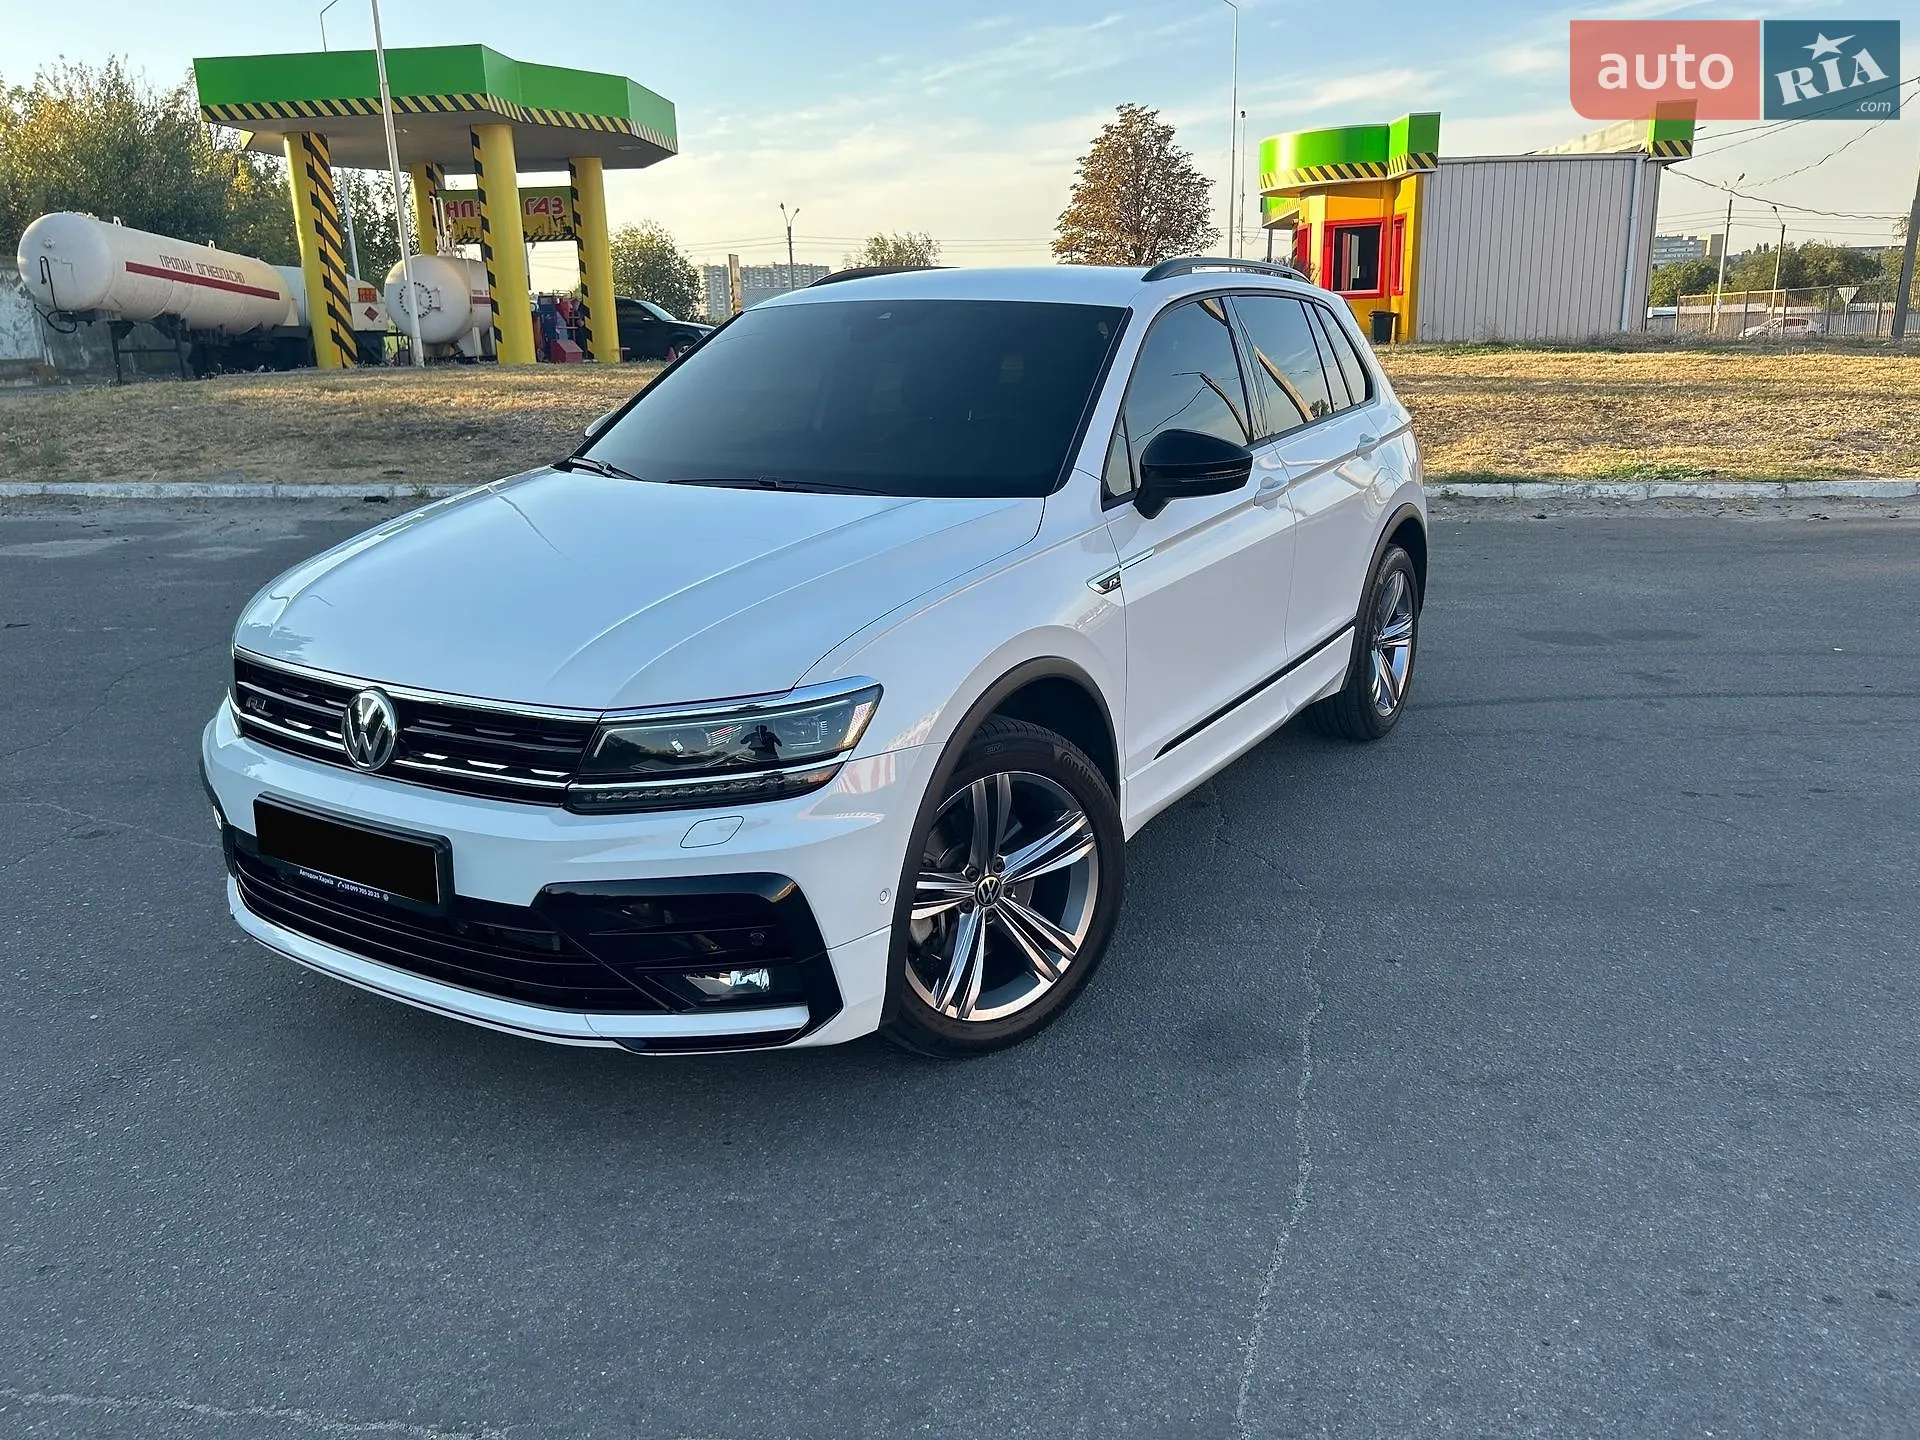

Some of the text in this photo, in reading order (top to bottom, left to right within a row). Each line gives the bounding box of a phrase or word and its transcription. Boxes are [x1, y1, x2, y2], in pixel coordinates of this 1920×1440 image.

[445, 196, 564, 218] НП ГАЗ
[159, 254, 246, 284] ПРОПАН ОГНЕОПАСНО
